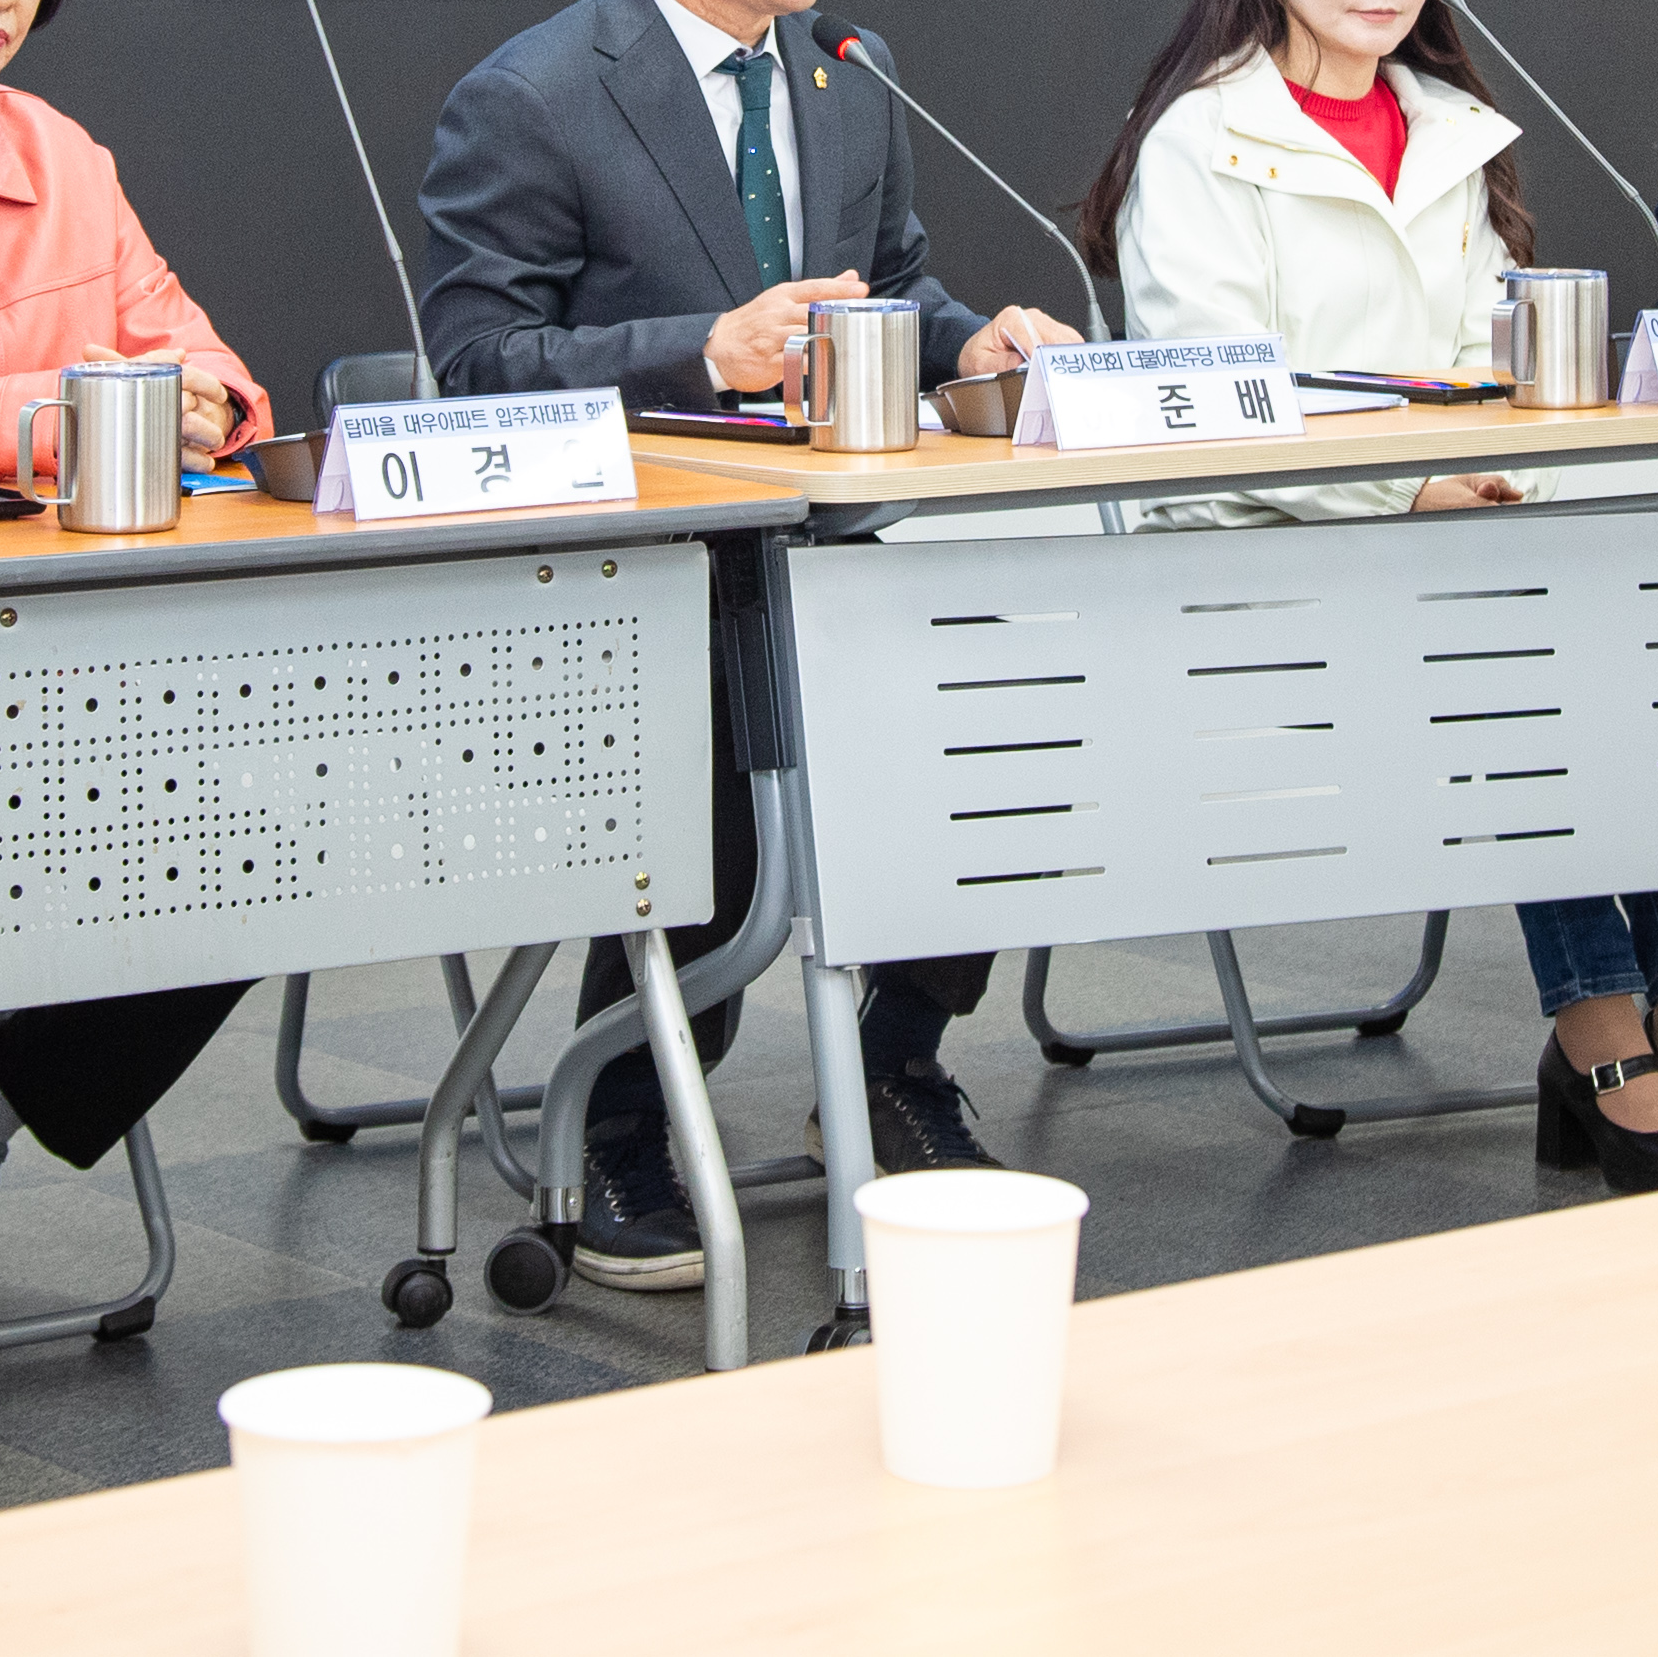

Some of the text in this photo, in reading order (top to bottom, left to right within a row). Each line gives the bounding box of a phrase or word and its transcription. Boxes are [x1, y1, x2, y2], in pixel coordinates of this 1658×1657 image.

[1049, 343, 1276, 374] 성남시의회 더불어민주당 대표의원
[344, 415, 396, 439] 탑마을
[404, 409, 489, 435] 대우아파트
[496, 402, 579, 428] 입주자대표
